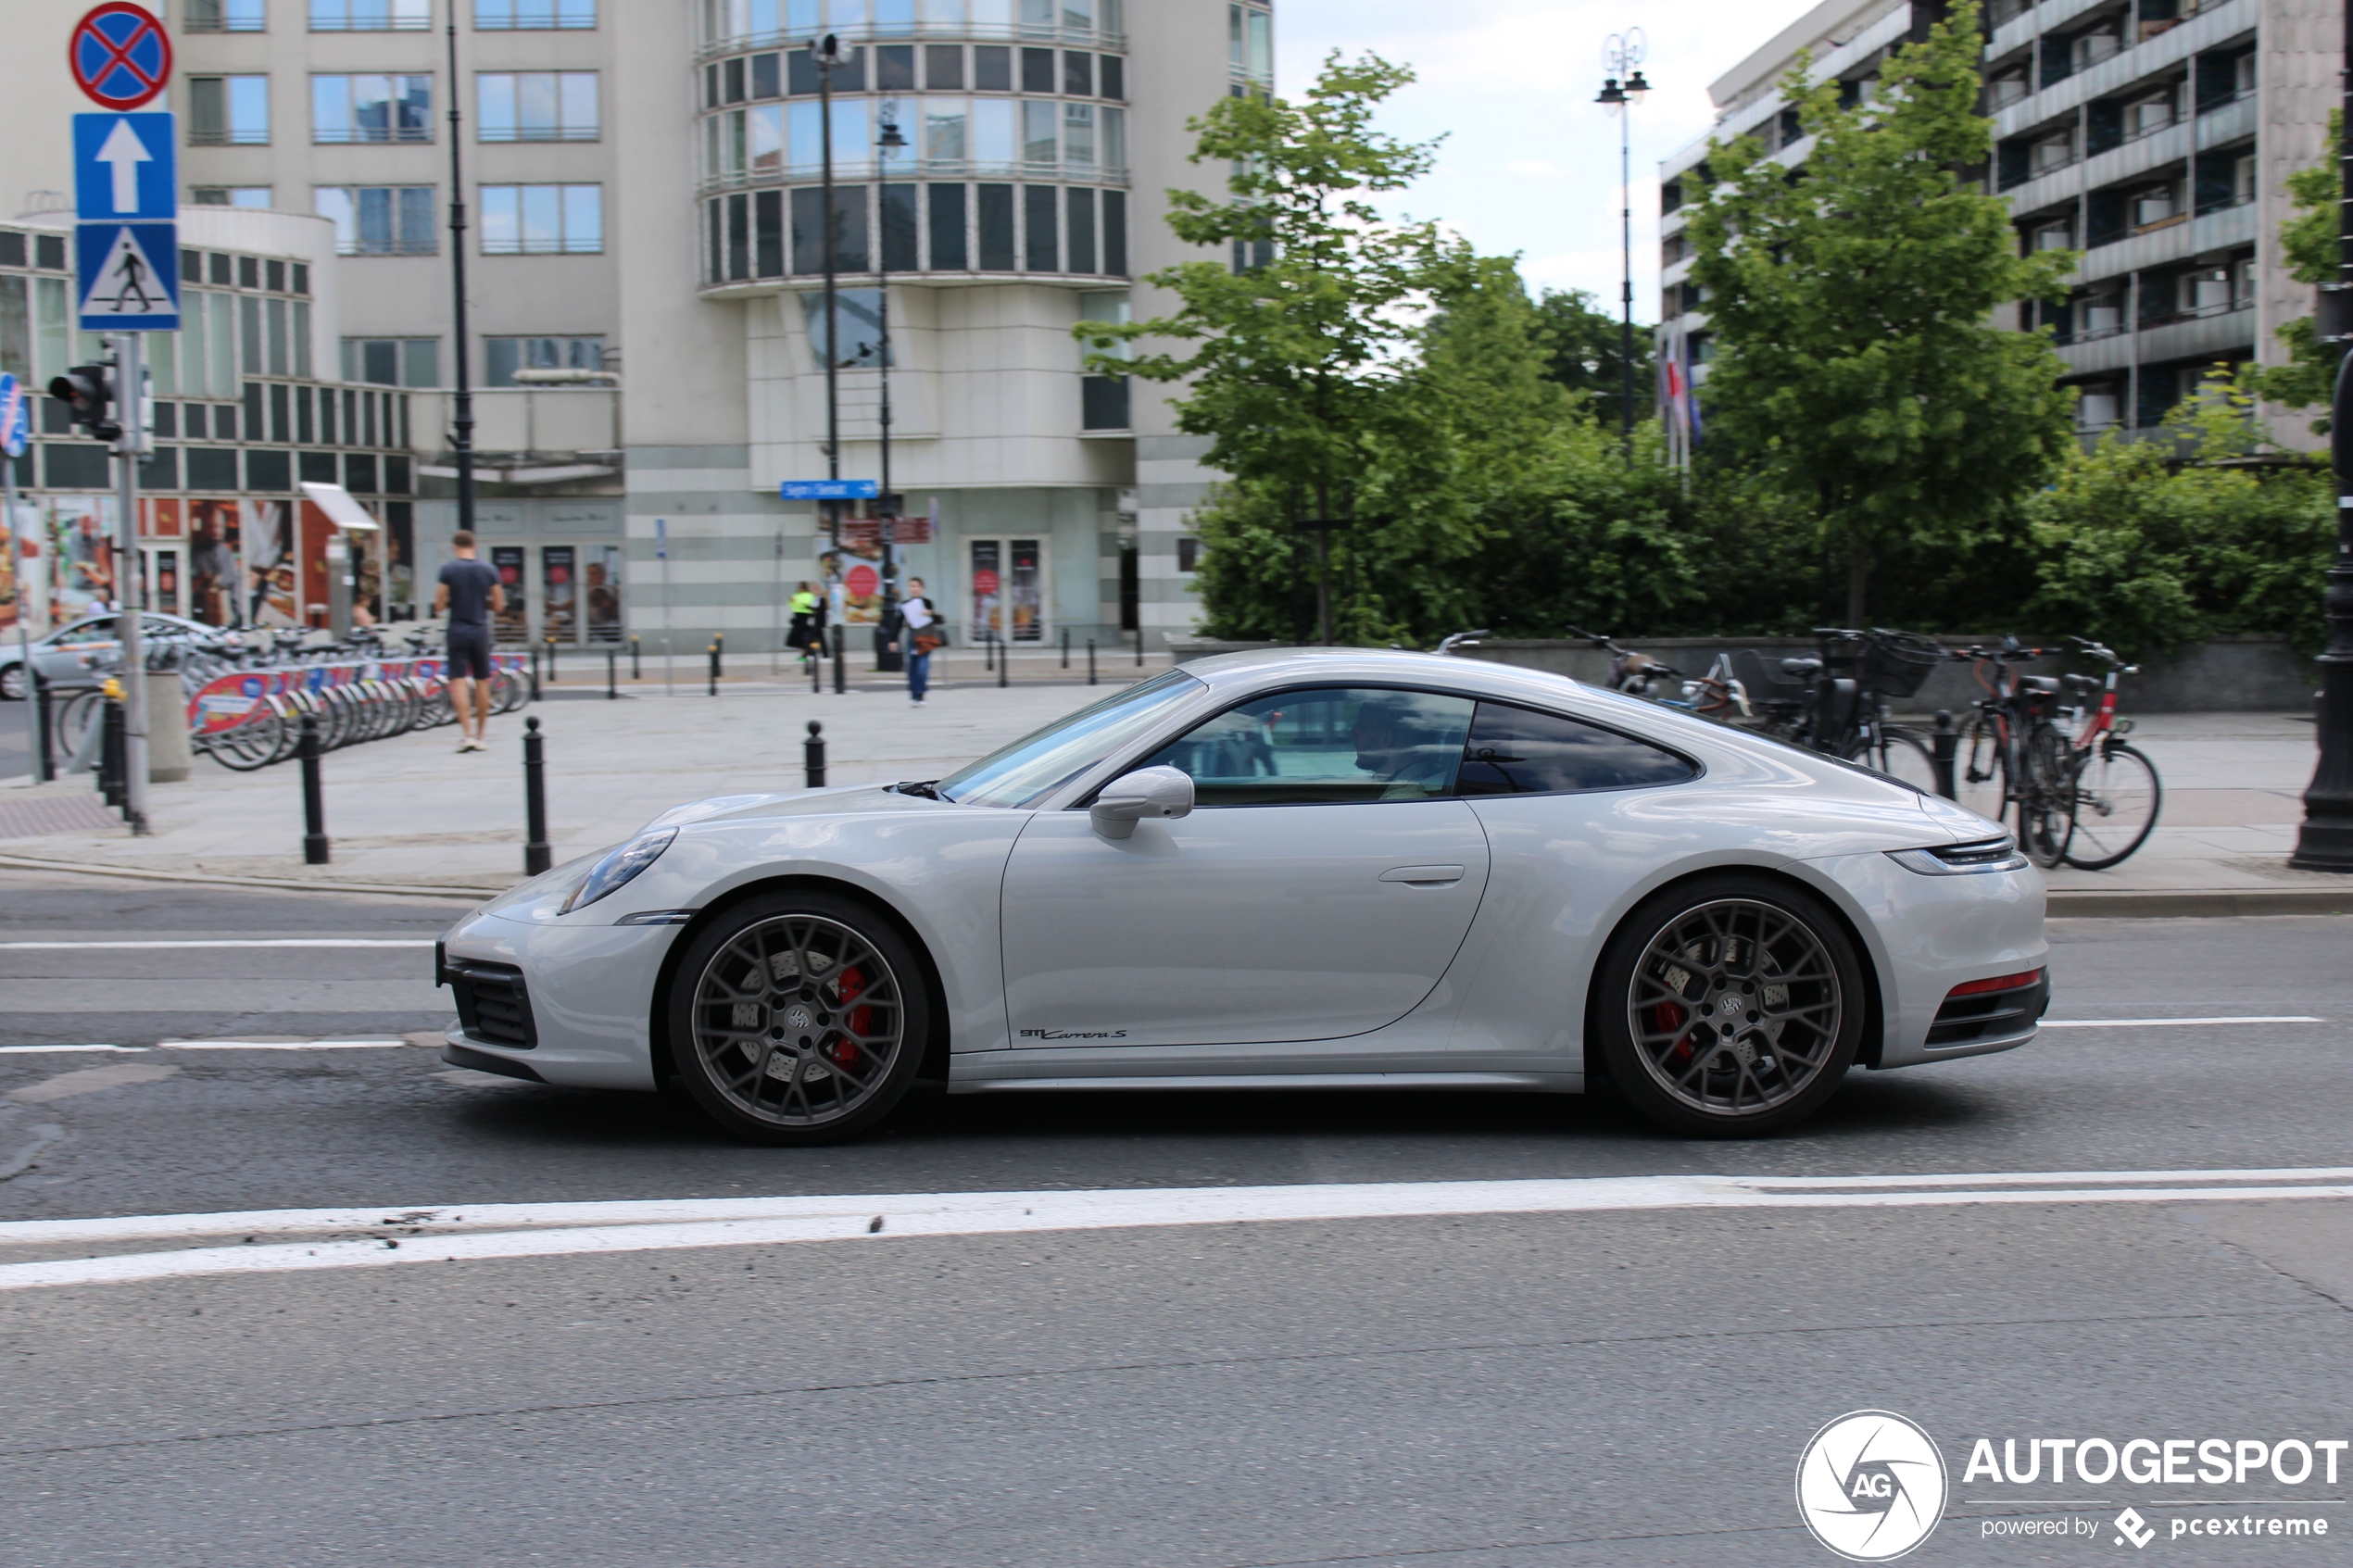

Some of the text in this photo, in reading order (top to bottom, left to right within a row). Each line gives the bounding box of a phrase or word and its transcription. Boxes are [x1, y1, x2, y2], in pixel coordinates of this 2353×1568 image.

[1020, 1029, 1127, 1039] 911 Carrera S
